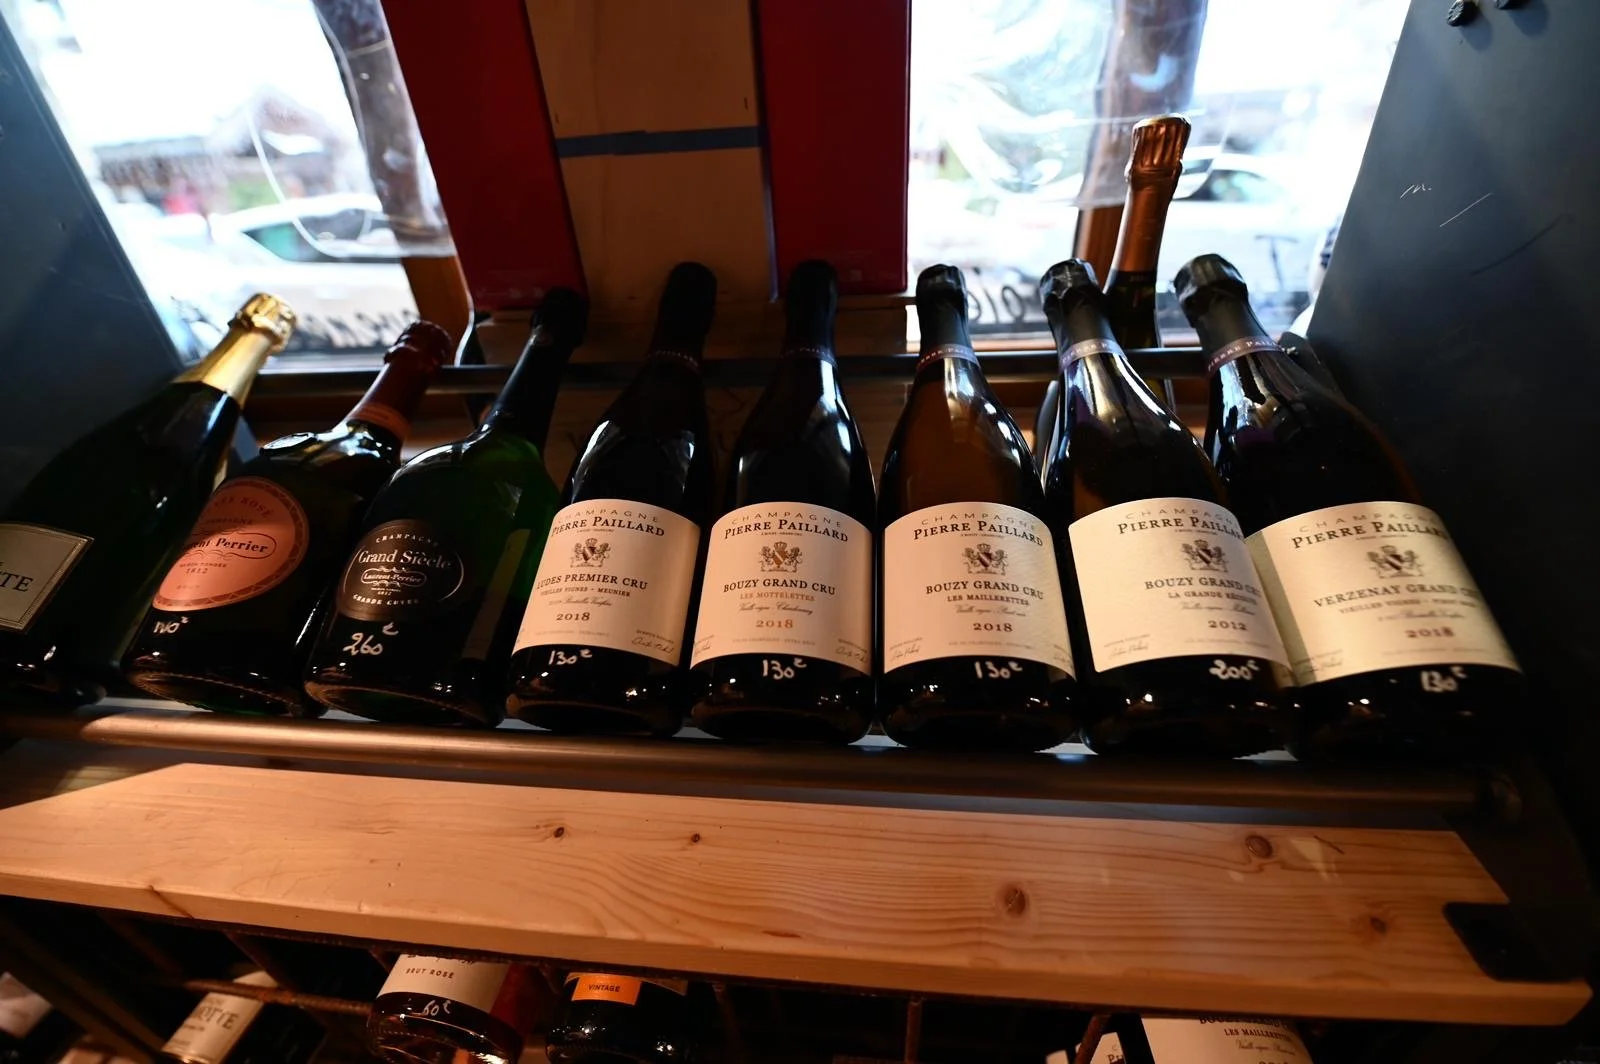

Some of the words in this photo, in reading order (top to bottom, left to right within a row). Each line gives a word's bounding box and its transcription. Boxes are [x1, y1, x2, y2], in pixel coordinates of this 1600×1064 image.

[558, 509, 659, 524] CHAMPAGNE
[731, 511, 842, 528] CHAMPAGNE
[921, 512, 1037, 531] CHAMPAGNE
[551, 519, 588, 537] PIERRE
[592, 516, 665, 538] PAILLARD
[724, 521, 772, 540] PIERRE
[778, 519, 849, 542] PAILLARD
[913, 522, 972, 541] PIERRE
[976, 520, 1044, 547] PAILLARD
[1117, 517, 1185, 535] PIERRE
[1291, 523, 1367, 549] PIERRE
[215, 537, 269, 553] Perrier
[358, 549, 398, 563] Grand
[400, 550, 452, 568] Siècle
[564, 573, 619, 585] PREMIER
[622, 577, 649, 590] CRU
[723, 579, 760, 593] BOUZY
[762, 578, 808, 589] GRAND
[811, 582, 836, 595] CRU
[1144, 577, 1194, 590] BOUZY
[1199, 576, 1244, 591] GRAND
[597, 587, 631, 597] MEUNIER
[740, 592, 754, 600] LES
[755, 591, 816, 602] MOTTELETTES
[925, 581, 969, 595] BOUZY
[972, 580, 1020, 593] GRAND
[1022, 587, 1045, 600] CRU
[1184, 591, 1222, 600] GRANDE
[1313, 584, 1401, 608] VERZENAY
[1405, 583, 1458, 594] GRAND
[946, 594, 964, 602] LES
[556, 611, 591, 622] 2018
[755, 619, 794, 629] 2018
[972, 622, 1014, 633] 2018
[1207, 620, 1248, 631] 2012
[405, 967, 427, 975] BRUT
[588, 983, 621, 993] VINTAGE
[1223, 1028, 1240, 1037] LES
